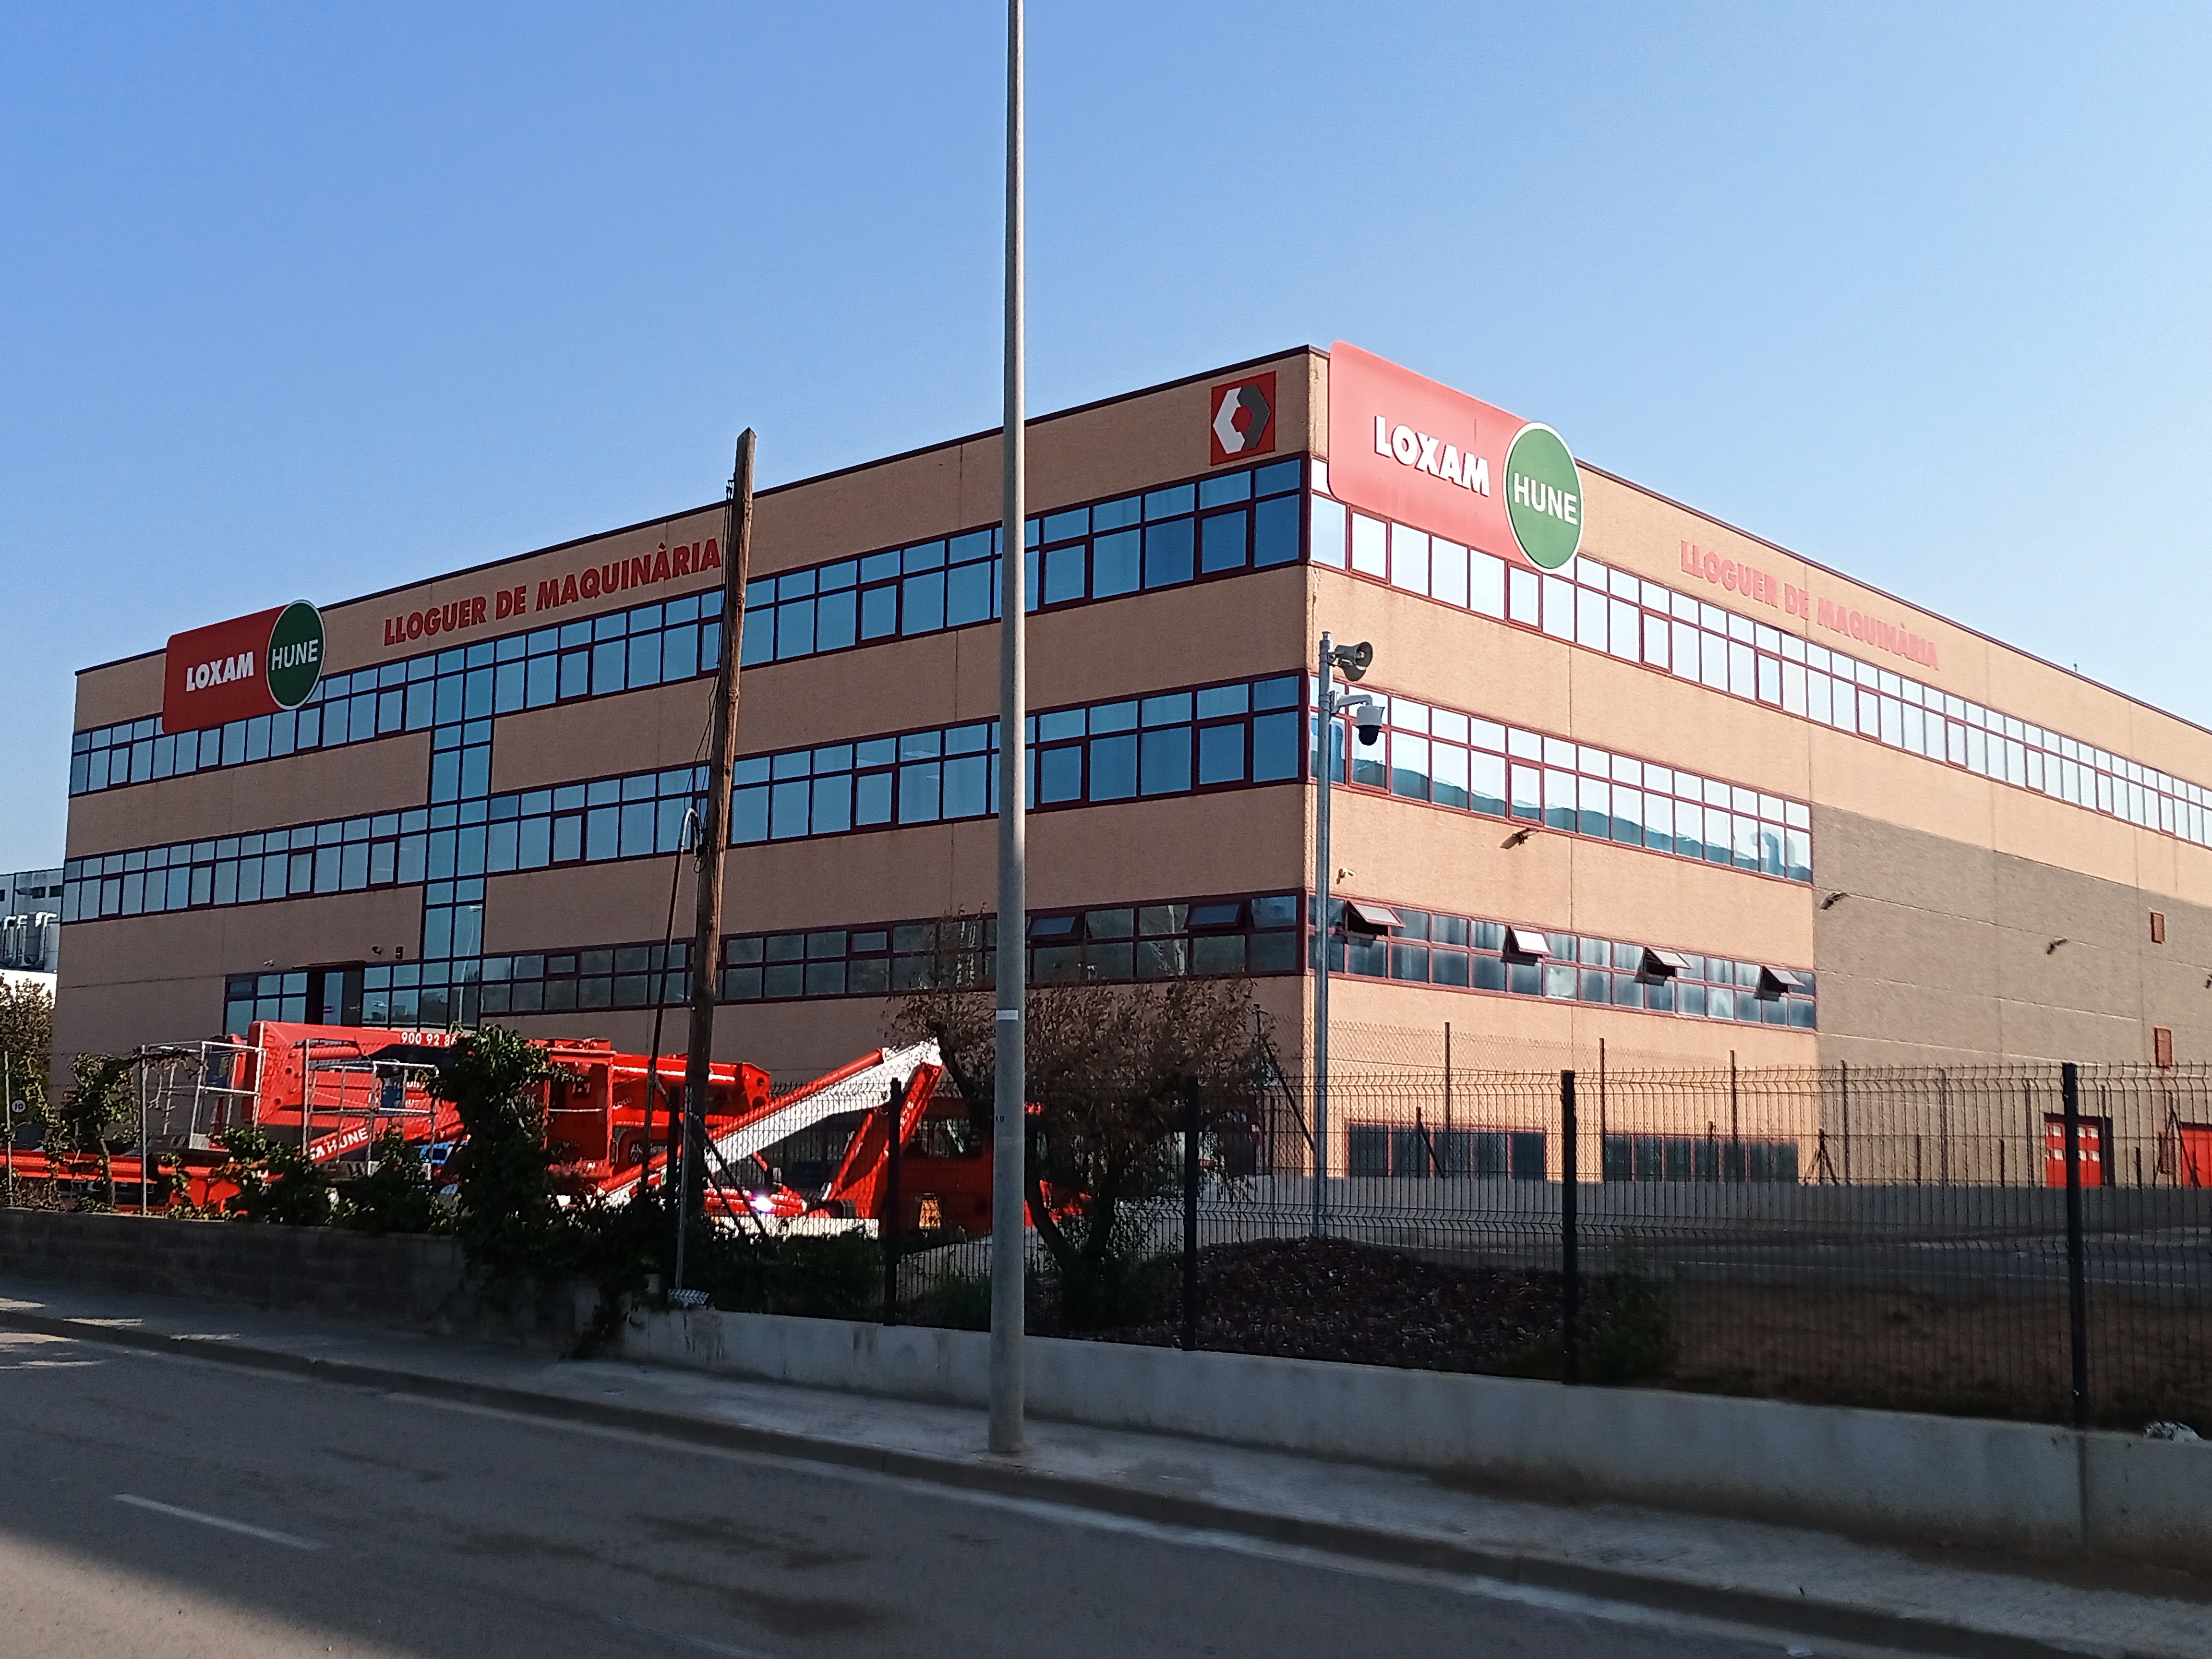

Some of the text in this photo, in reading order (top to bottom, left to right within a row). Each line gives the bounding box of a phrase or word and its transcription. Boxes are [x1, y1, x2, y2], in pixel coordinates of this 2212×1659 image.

[1374, 415, 1490, 497] LOXAM
[1514, 472, 1578, 526] HUNE
[384, 538, 721, 646] LLOGUER DE MAQUINÀRIA
[1681, 540, 1778, 608] LLOGUER
[1784, 582, 1809, 620] DE
[186, 651, 253, 692] LOXAM
[271, 639, 318, 671] HUNE
[401, 1032, 422, 1045] 900
[426, 1034, 440, 1046] 92
